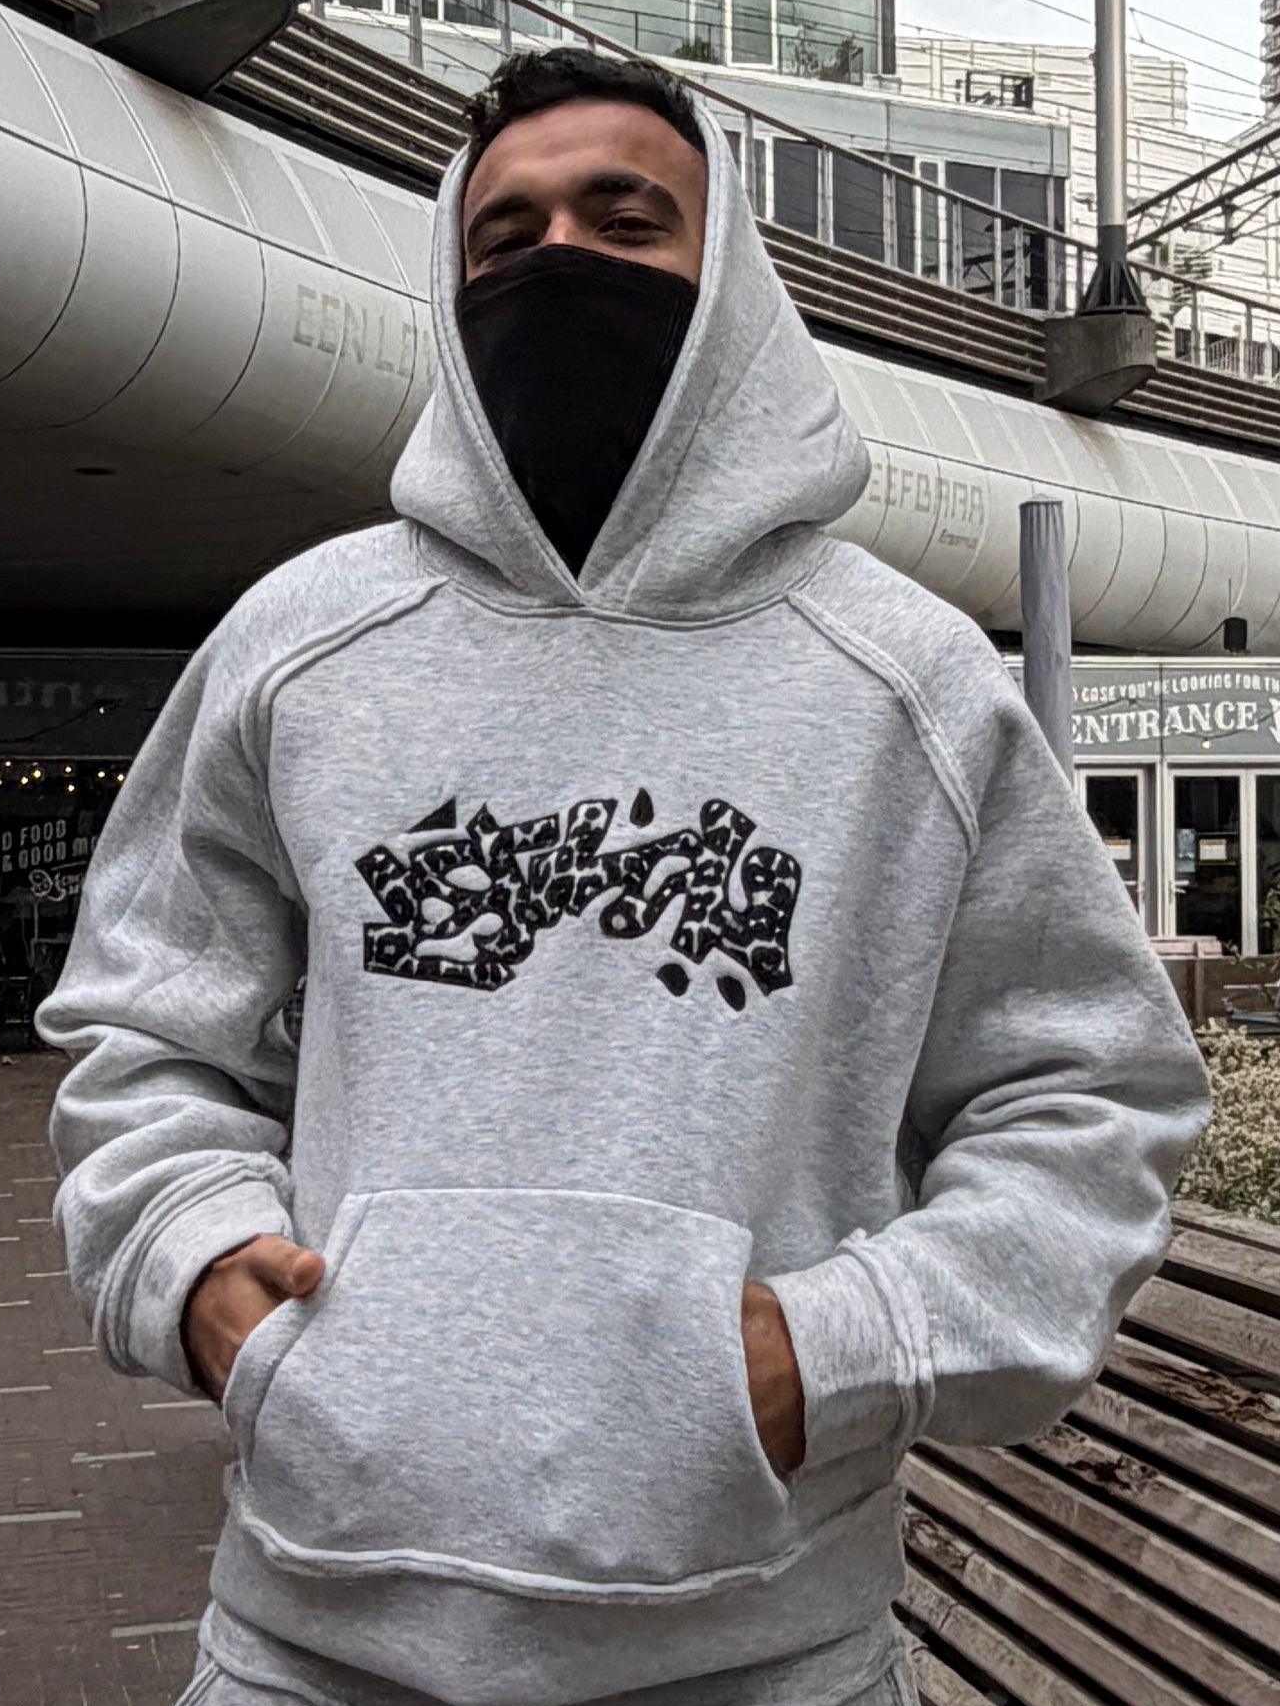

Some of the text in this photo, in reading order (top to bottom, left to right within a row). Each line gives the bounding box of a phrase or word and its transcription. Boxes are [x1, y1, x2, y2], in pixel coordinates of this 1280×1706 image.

[1172, 673, 1233, 694] LOOKING
[1235, 673, 1261, 690] FOR
[20, 819, 66, 847] FOOD
